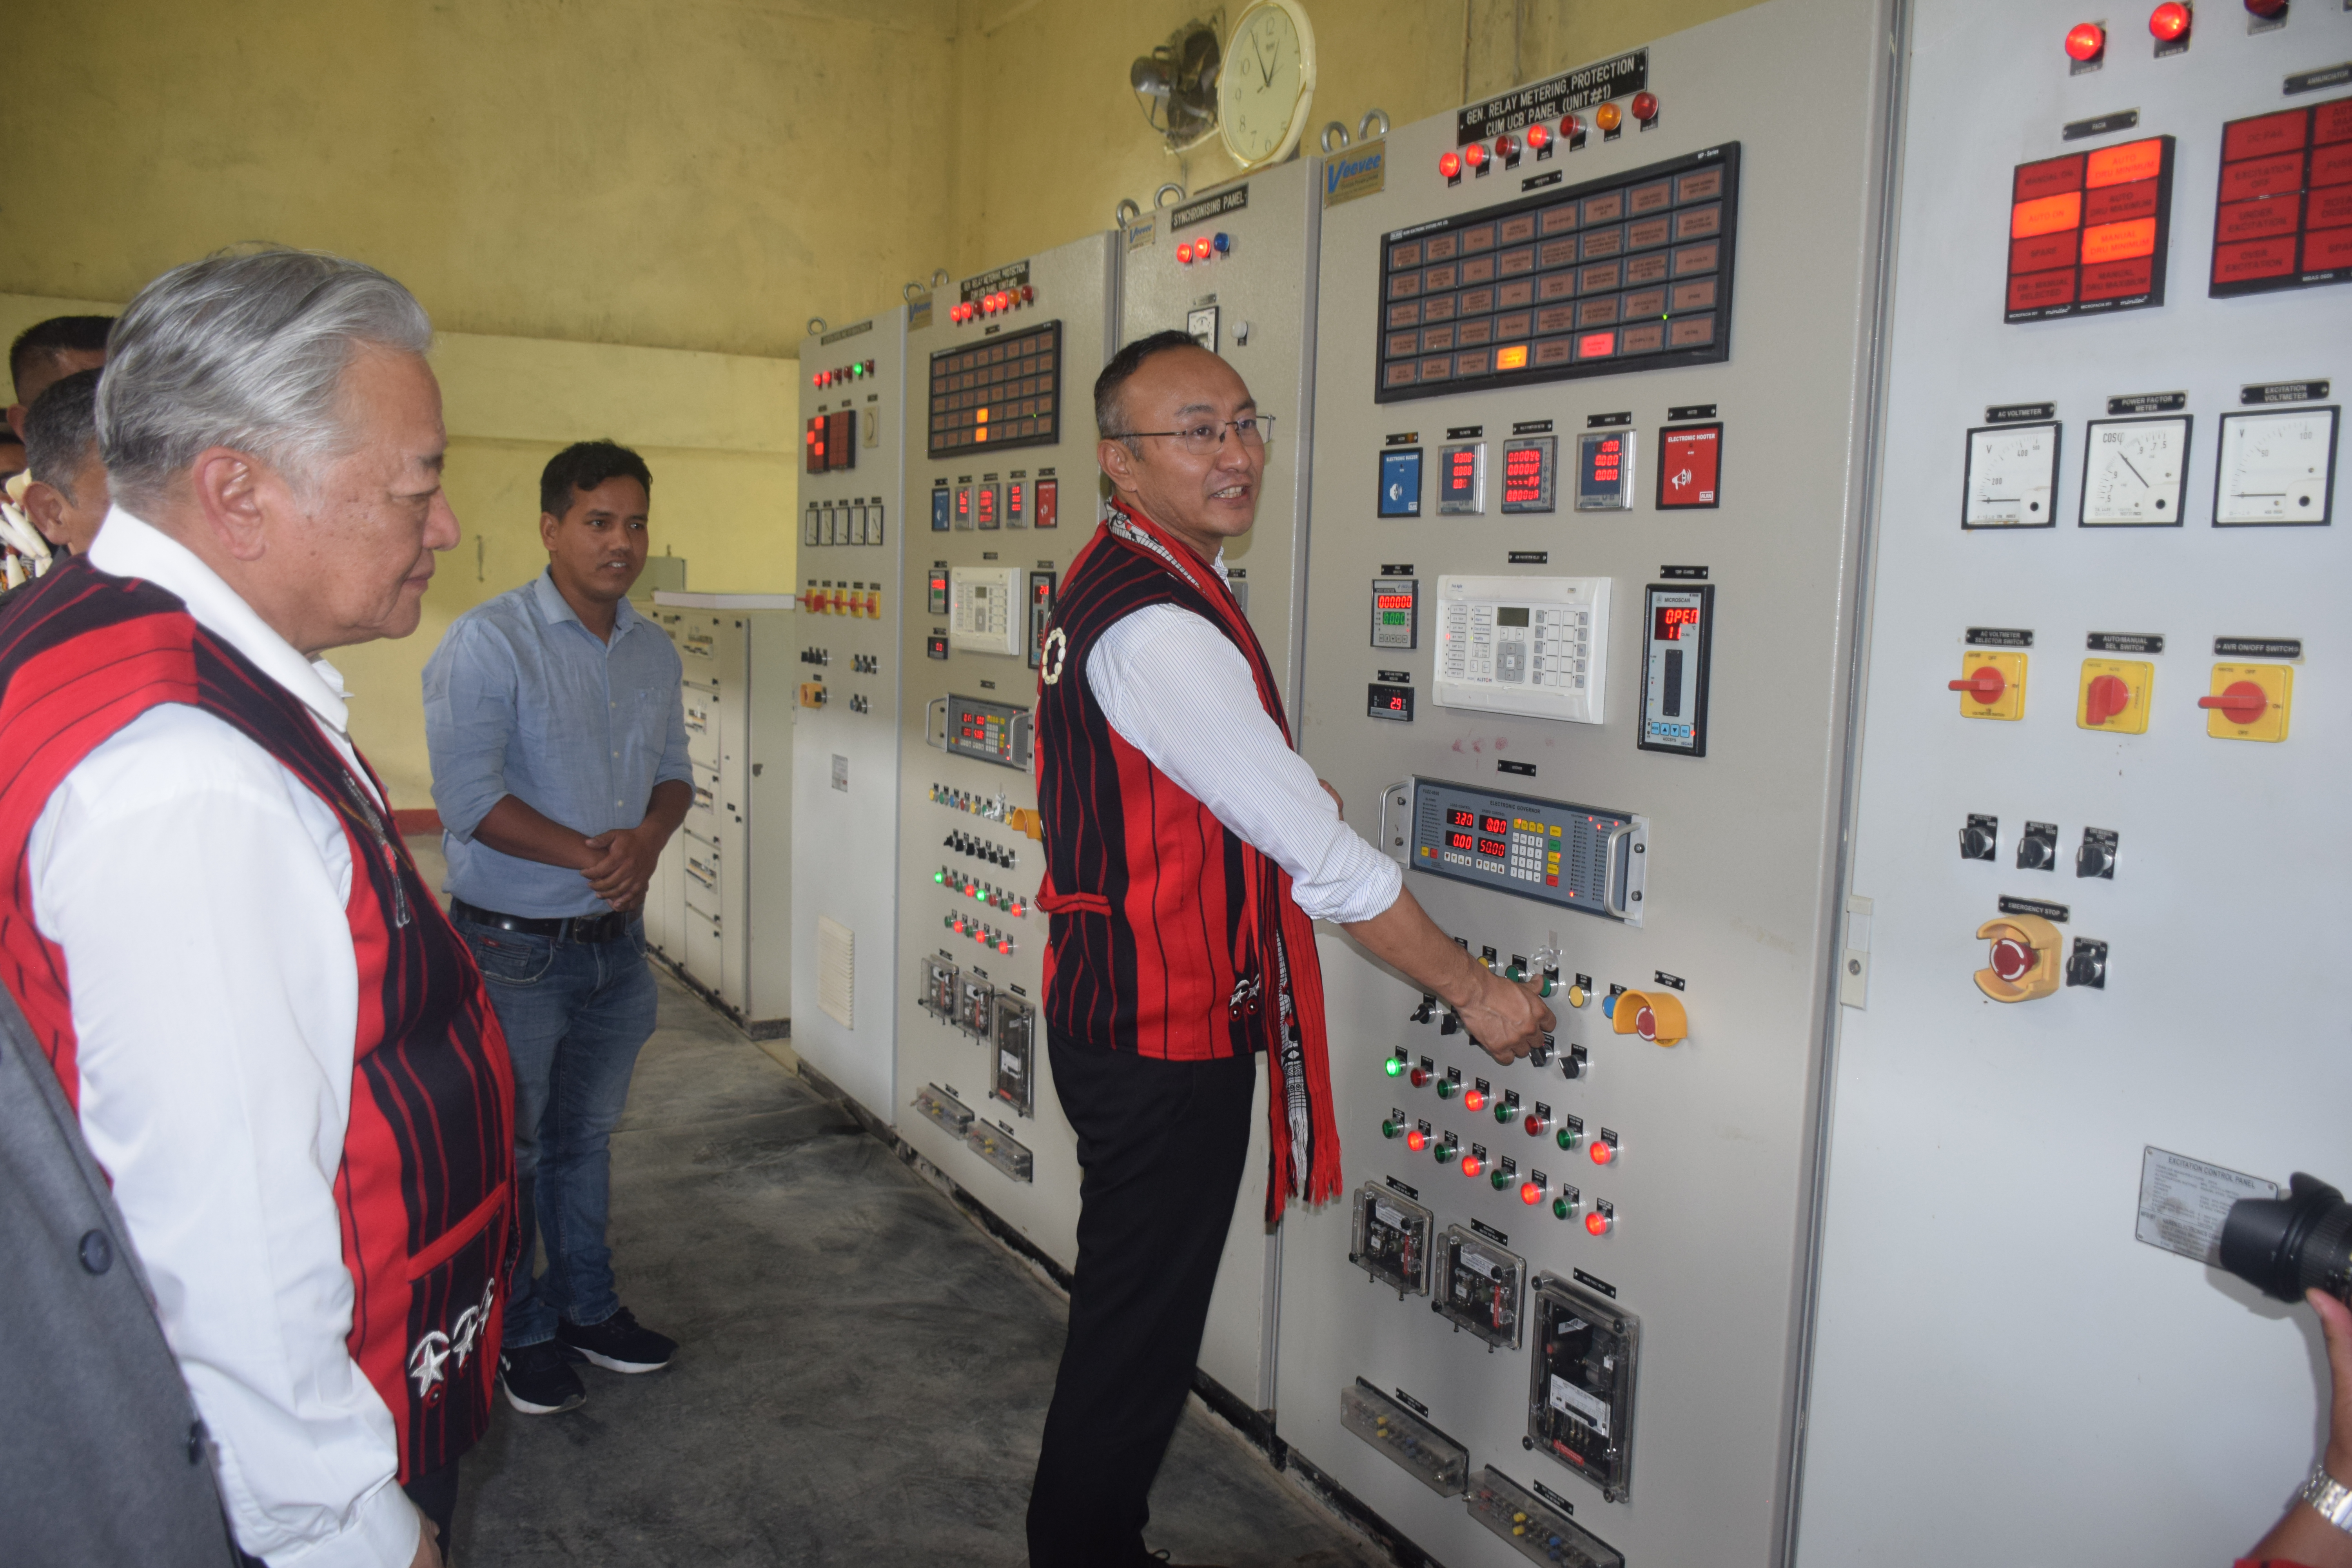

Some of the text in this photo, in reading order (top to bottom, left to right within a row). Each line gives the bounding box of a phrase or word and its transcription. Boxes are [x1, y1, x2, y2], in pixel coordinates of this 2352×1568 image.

[1267, 17, 1274, 35] 12
[1241, 58, 1250, 75] 10
[2307, 70, 2348, 85] ANNUNCIATOR
[1467, 56, 1634, 125] GEN. RELAY PROTECTION
[1486, 84, 1611, 136] CUM UCB (UNIT #1)
[1240, 114, 1245, 132] 8
[2092, 122, 2106, 131] FACIA
[1251, 130, 1257, 149] 7
[1707, 149, 1719, 157] Series
[2113, 154, 2136, 165] AUTO
[1328, 154, 1381, 194] Veevee
[2095, 161, 2154, 179] DRU MINIMUM
[2235, 163, 2293, 181] EXCITATION
[2025, 172, 2057, 185] MANUAL
[2109, 192, 2132, 203] AUTO
[1174, 191, 1245, 227] SYNCHRONISING PANEL
[2109, 199, 2152, 213] MAXIMUM
[2029, 210, 2065, 223] AUTO ON
[2228, 217, 2287, 233] EXCITATION
[2101, 231, 2135, 243] MANUAL
[2030, 247, 2056, 258] SPARE
[2090, 238, 2150, 255] DRU MINIMUM
[2225, 259, 2282, 272] EXCITATION
[2099, 269, 2132, 279] MANUAL
[2105, 277, 2147, 289] MAXIMUM
[2020, 289, 2062, 301] SELECTED
[2265, 385, 2307, 394] EXCITATION
[2122, 395, 2172, 405] POWER FACTOR
[2265, 392, 2307, 401] VOLTMETER
[2240, 429, 2245, 438] V
[2300, 432, 2312, 440] 100
[1986, 445, 1992, 454] V
[1669, 626, 1681, 639] 11
[2103, 635, 2148, 644] AUTO/MANUAL
[2265, 645, 2293, 653] SWITCH
[1490, 800, 1540, 814] ELECTRONIC GOVERNOR
[1453, 834, 1472, 850] 0.00
[1480, 840, 1505, 857] 50.00
[2008, 902, 2060, 916] EMERGENCY STOP
[2169, 1156, 2256, 1189] EXCITATION CONTROL PANEL
